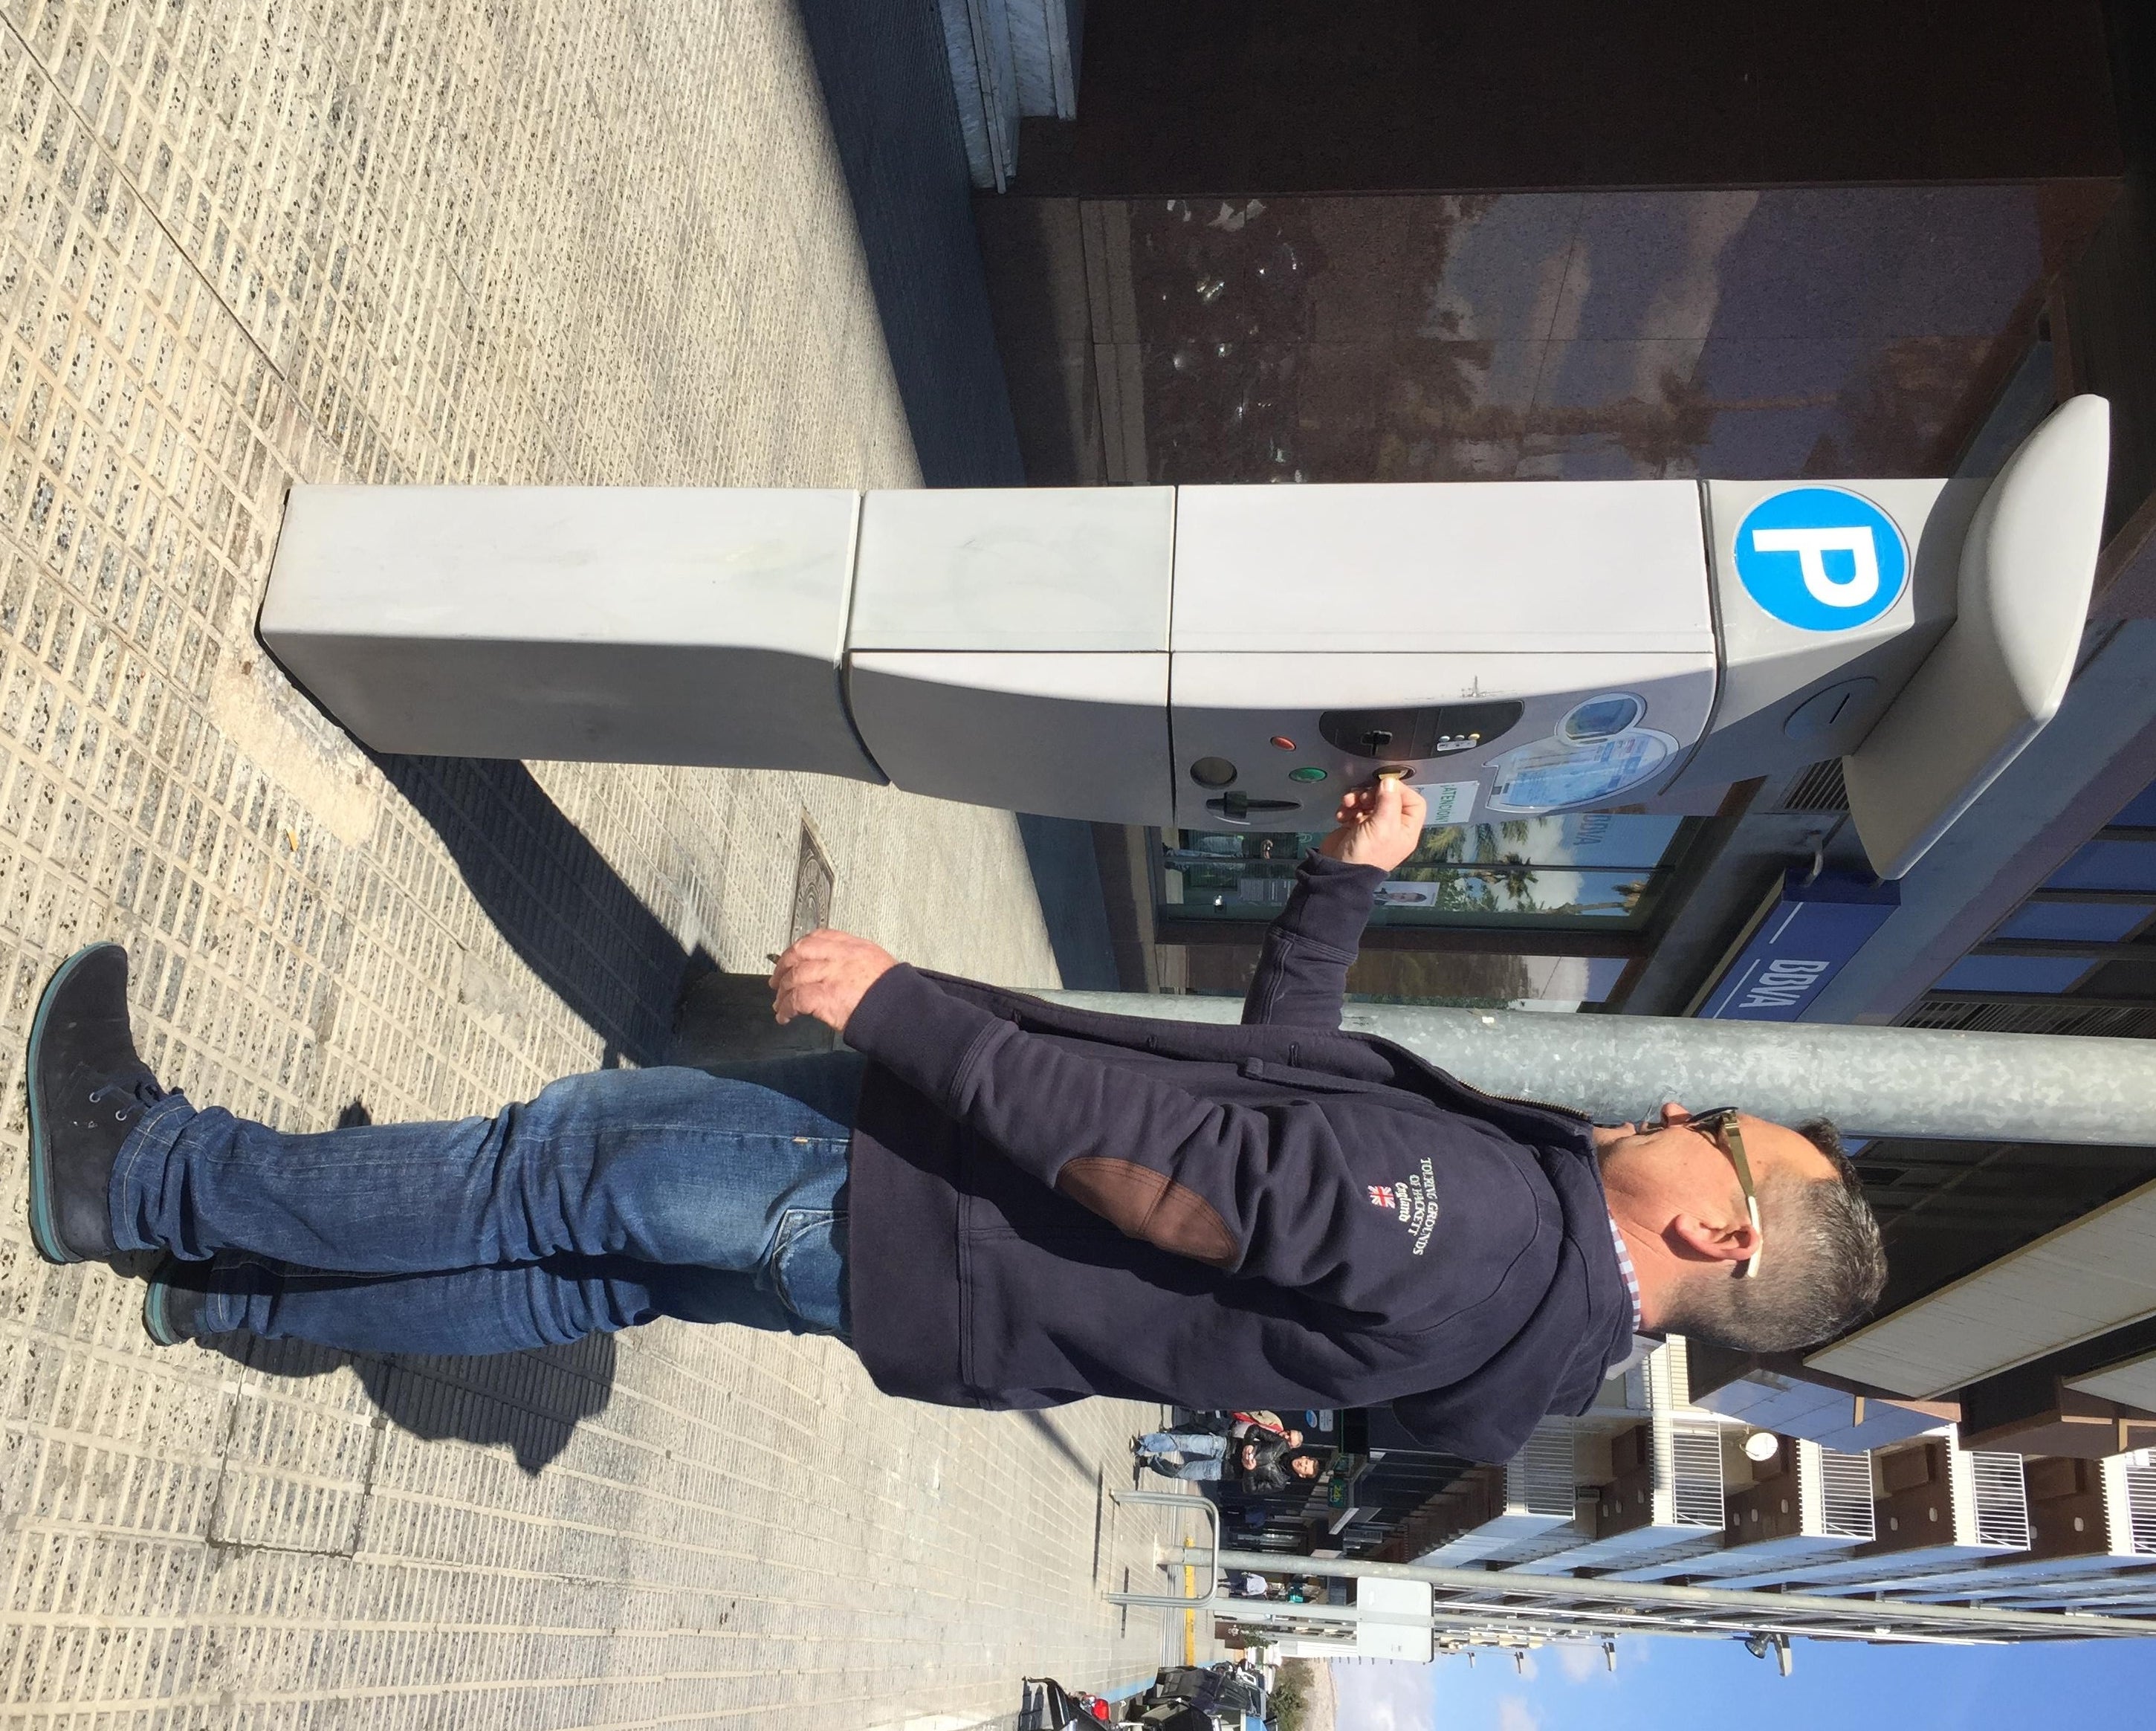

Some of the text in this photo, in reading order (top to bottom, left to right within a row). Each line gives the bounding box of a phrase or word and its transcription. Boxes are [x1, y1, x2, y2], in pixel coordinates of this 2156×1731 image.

[1751, 526, 1878, 608] P
[1738, 960, 1830, 1008] BBVA
[1394, 1182, 1411, 1222] England
[1407, 1174, 1425, 1236] OF HACKETT
[1412, 1157, 1437, 1255] TOURING GROUNDS
